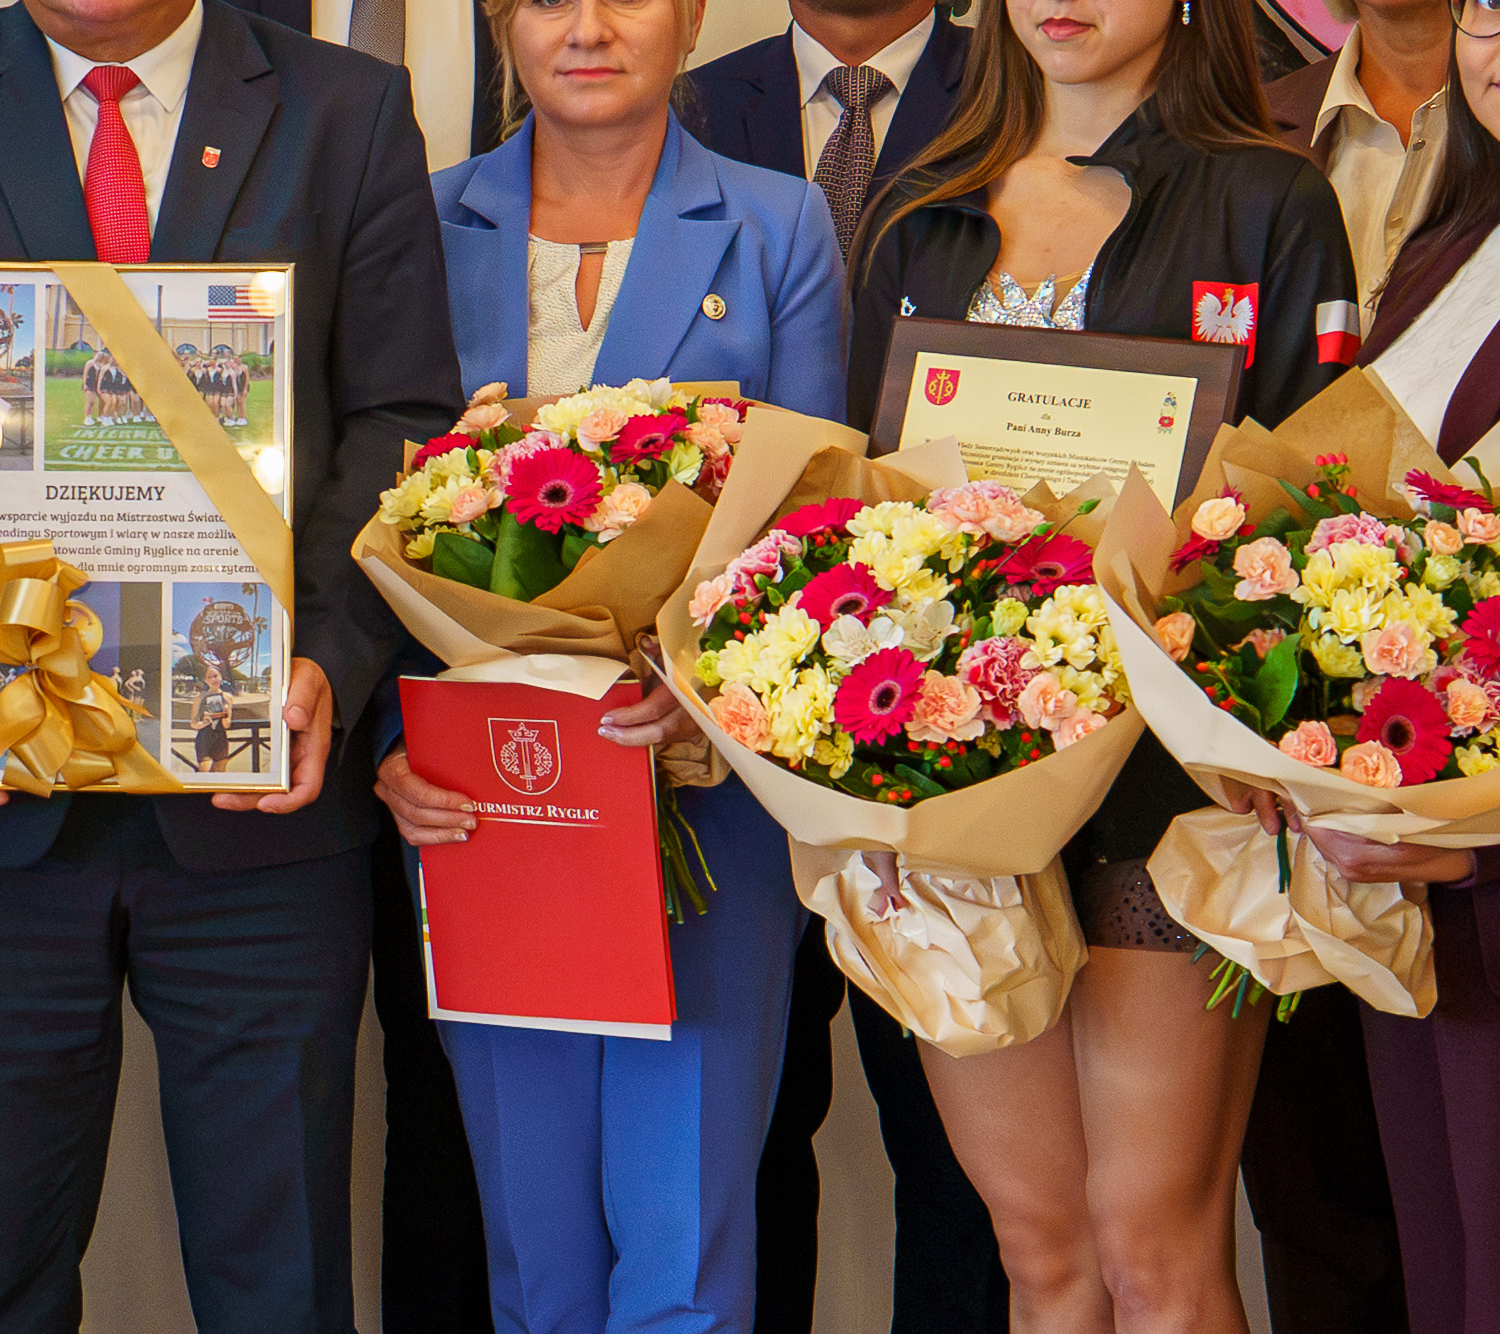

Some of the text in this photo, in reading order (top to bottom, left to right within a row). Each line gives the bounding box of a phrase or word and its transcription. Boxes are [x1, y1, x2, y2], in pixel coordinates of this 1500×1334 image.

[1007, 391, 1092, 409] GRATULACJE
[1006, 422, 1082, 438] Pani Anny Burza
[59, 444, 145, 460] CHEER
[45, 485, 166, 505] DZIĘKUJEMY
[50, 511, 97, 524] wyjazdu
[99, 514, 114, 522] na
[116, 511, 185, 523] Mistrzostwa
[43, 528, 108, 540] Sportowym
[110, 528, 114, 538] i
[116, 529, 148, 541] wiarę
[150, 530, 161, 539] w
[162, 530, 195, 539] nasze
[197, 528, 237, 540] możliw
[104, 545, 141, 558] Gminy
[143, 545, 184, 558] Ryglice
[186, 547, 200, 556] na
[203, 546, 239, 556] arenie
[97, 562, 124, 572] mnie
[127, 563, 188, 575] ogromnym
[546, 804, 600, 820] RYGLIC
